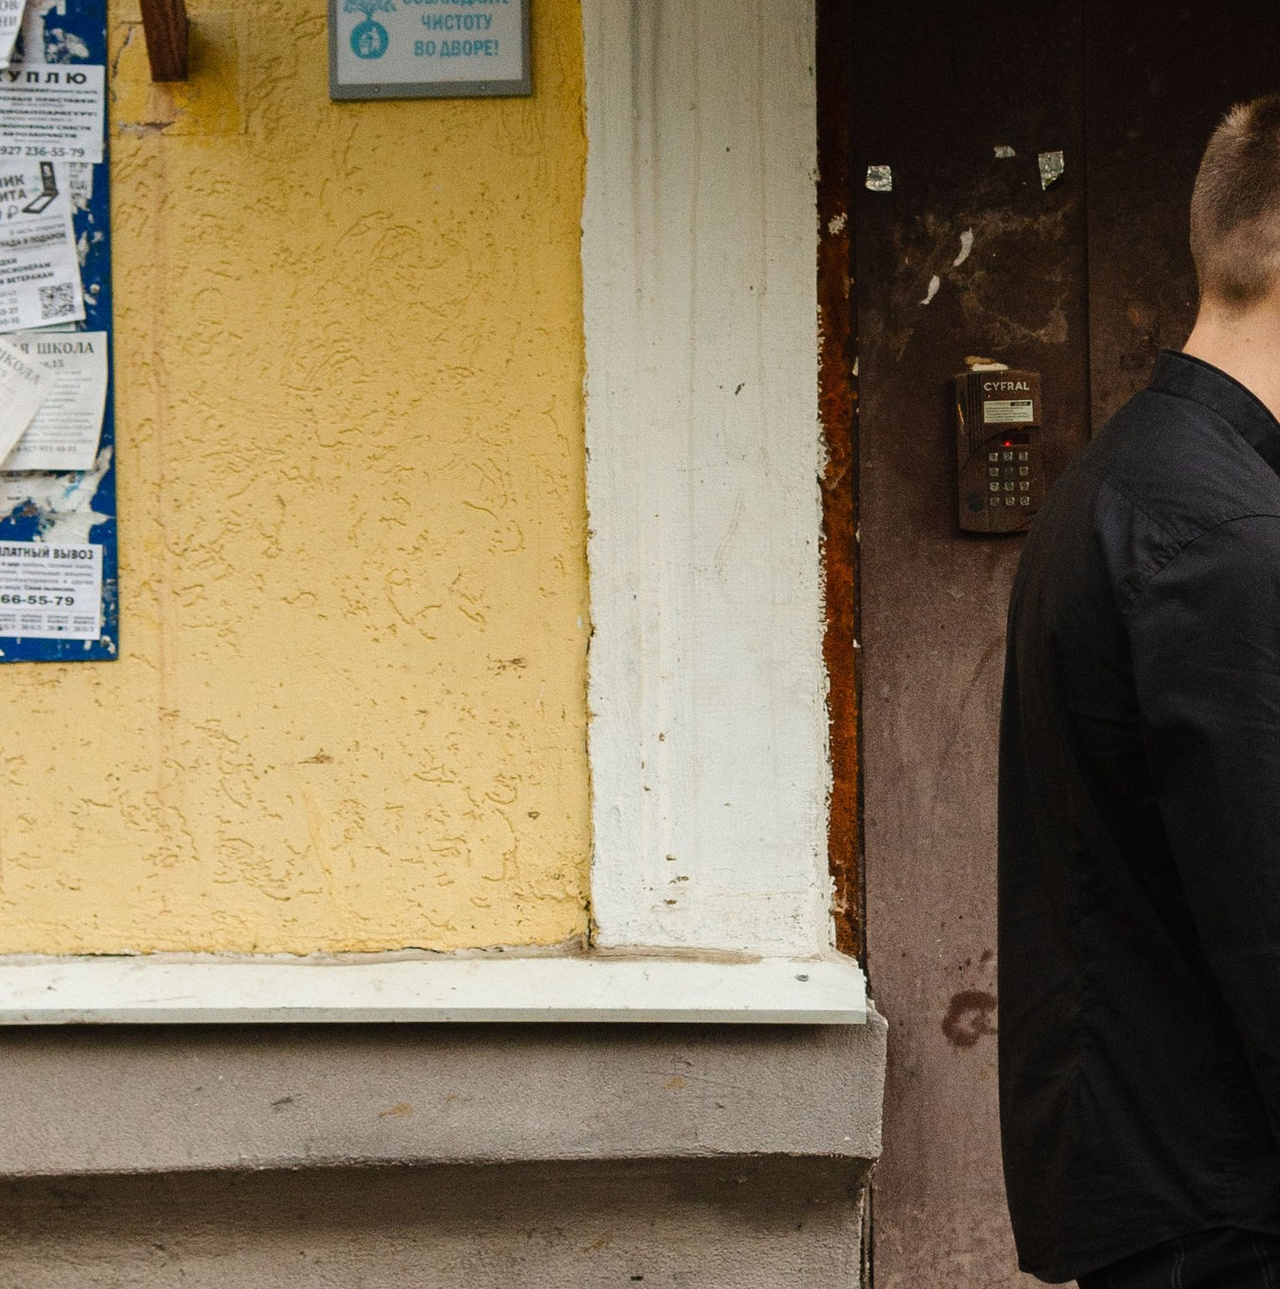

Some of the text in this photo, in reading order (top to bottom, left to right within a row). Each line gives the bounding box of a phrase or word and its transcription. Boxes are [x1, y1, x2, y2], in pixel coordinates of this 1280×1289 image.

[421, 13, 493, 31] ЧИСТОТУ
[413, 38, 499, 58] ВО ДВОРЕ!
[0, 70, 87, 85] УПЛЮ
[36, 341, 94, 354] ШКОЛА
[983, 381, 1030, 392] CYFRAL
[53, 548, 94, 561] ВЫВОЗ
